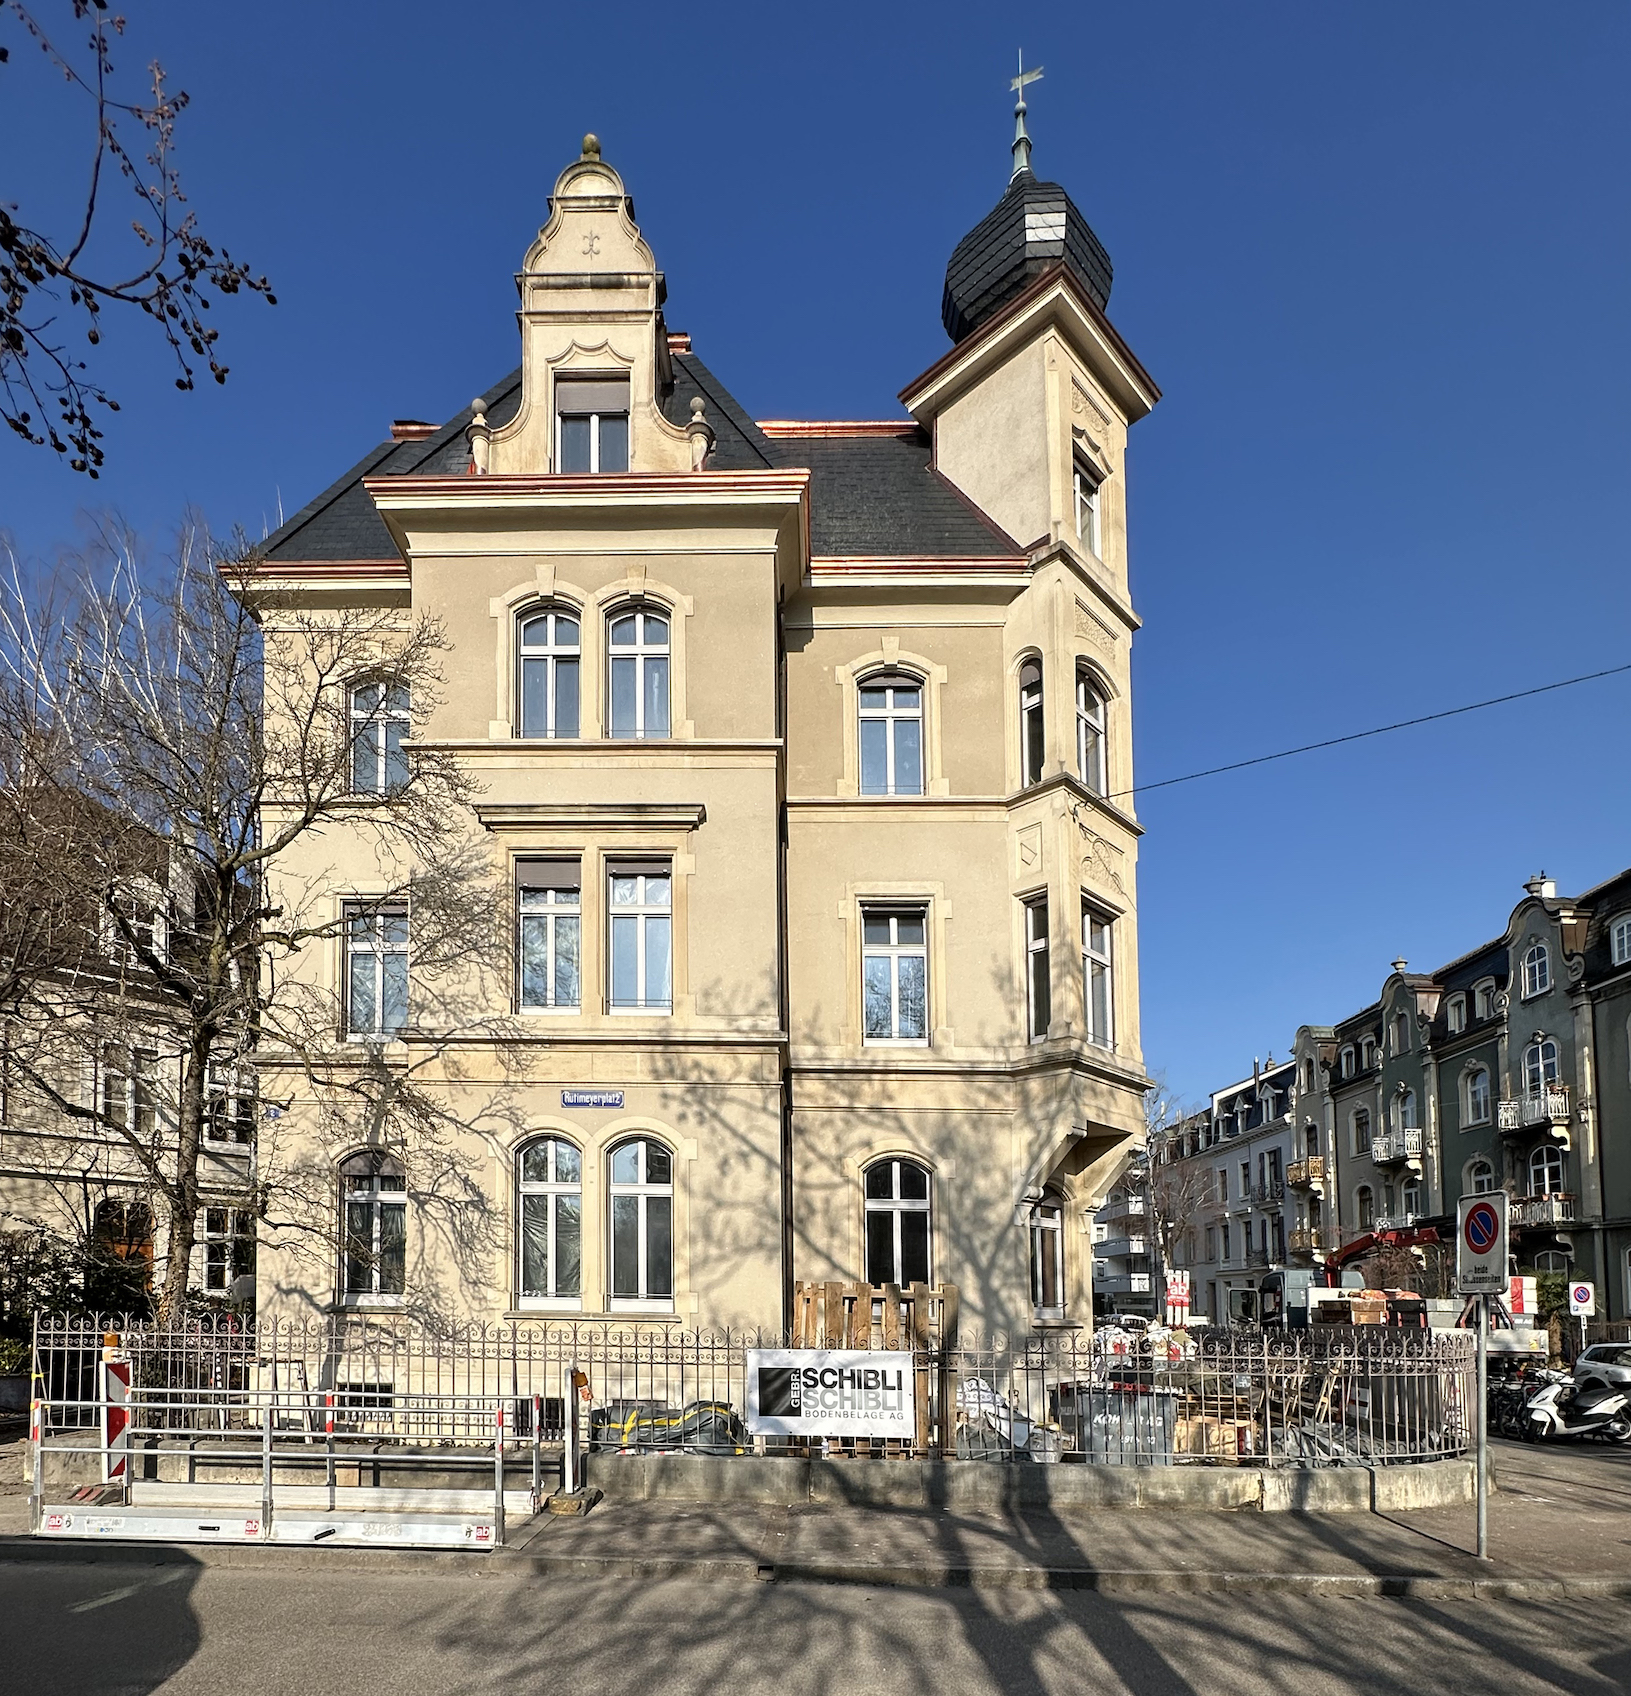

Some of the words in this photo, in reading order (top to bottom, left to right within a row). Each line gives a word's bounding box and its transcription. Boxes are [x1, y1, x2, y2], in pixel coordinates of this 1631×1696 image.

[1474, 1264, 1488, 1274] beide
[1462, 1274, 1501, 1284] Stssenseiten
[802, 1368, 903, 1391] SCHIBLI
[790, 1370, 801, 1408] GEBR.
[802, 1388, 904, 1411] SCHIBLI
[889, 1412, 904, 1420] AG
[49, 1515, 63, 1526] ab
[246, 1520, 259, 1531] ab
[476, 1526, 490, 1536] ab
